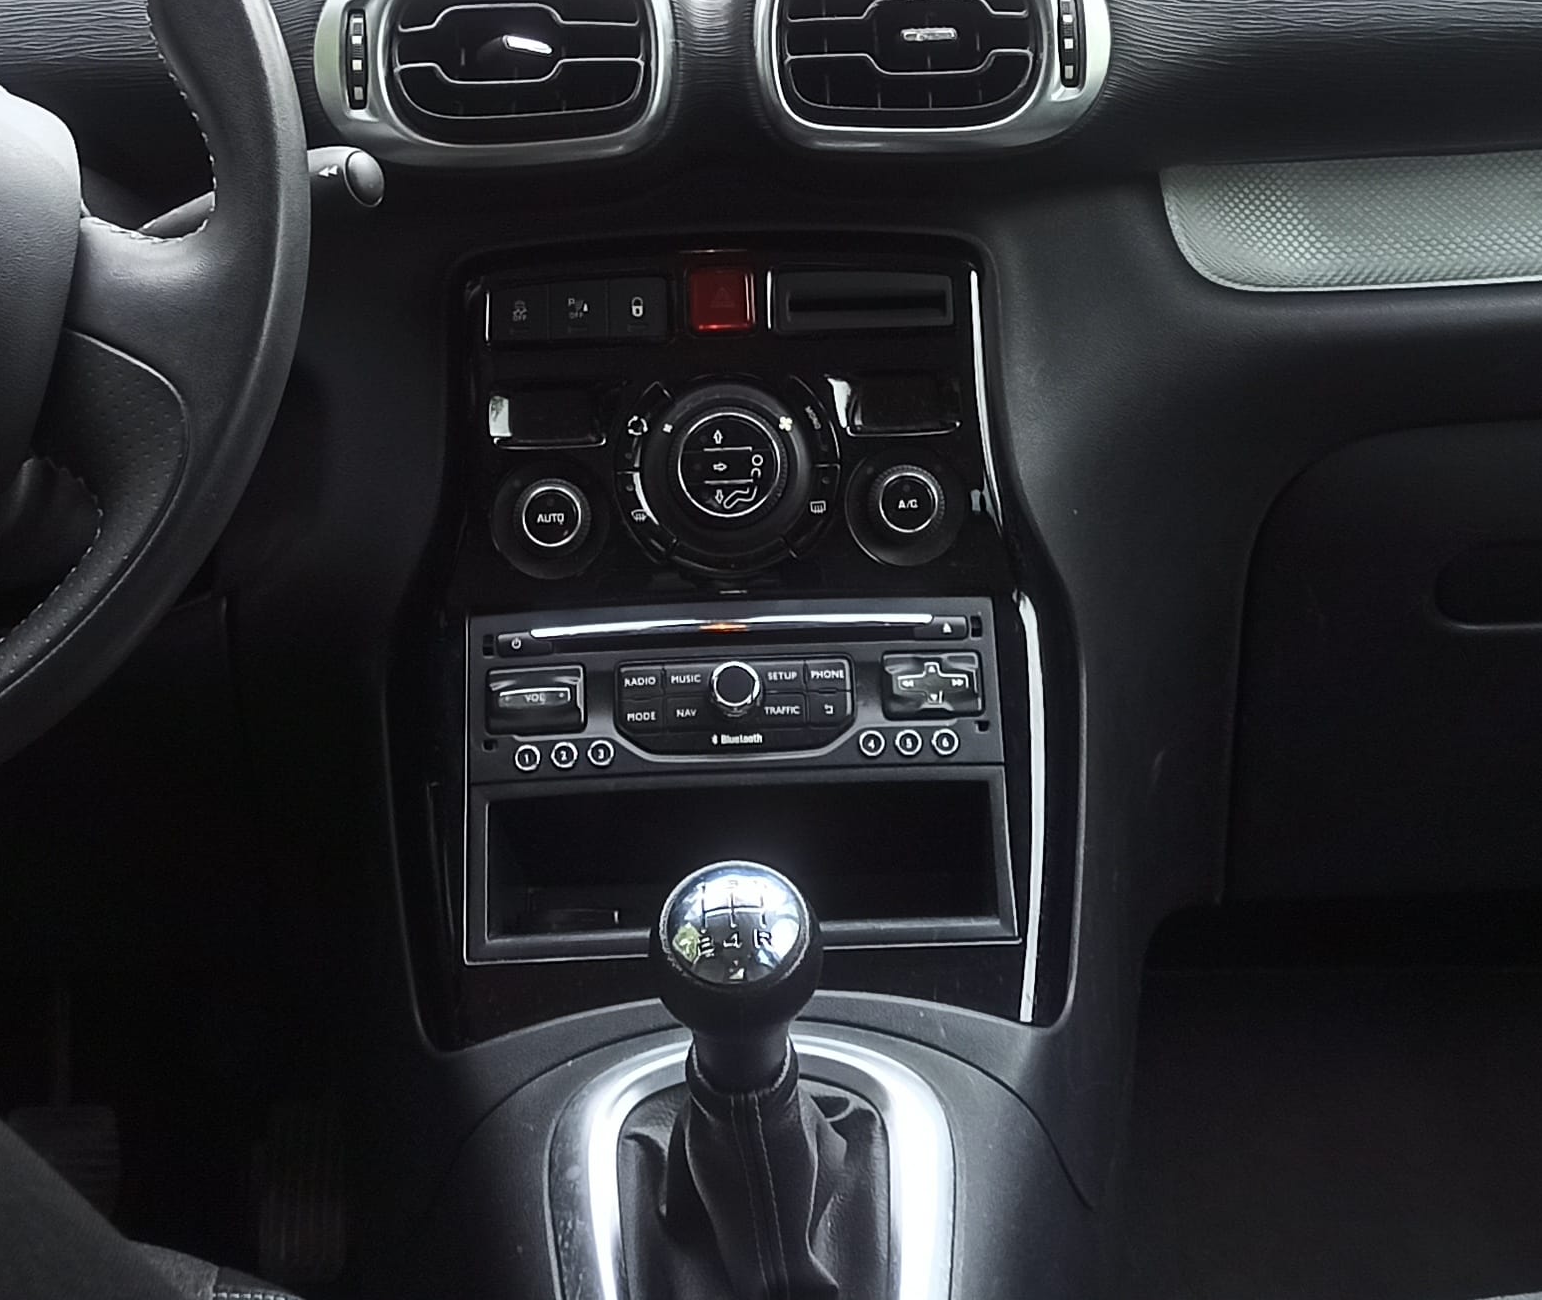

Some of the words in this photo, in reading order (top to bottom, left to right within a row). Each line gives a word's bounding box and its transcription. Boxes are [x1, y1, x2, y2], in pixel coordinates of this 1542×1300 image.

[898, 498, 919, 509] A/C
[537, 512, 565, 523] AUTO
[670, 674, 702, 684] MUSIC
[767, 671, 797, 681] SETUP
[810, 670, 845, 679] PHONE
[624, 676, 657, 687] RADIO
[524, 693, 546, 703] VOL
[676, 709, 697, 718] NAV
[764, 706, 801, 715] TRAFFIC
[626, 711, 657, 722] MODE
[720, 733, 763, 745] Bluetooth
[753, 928, 773, 950] R
